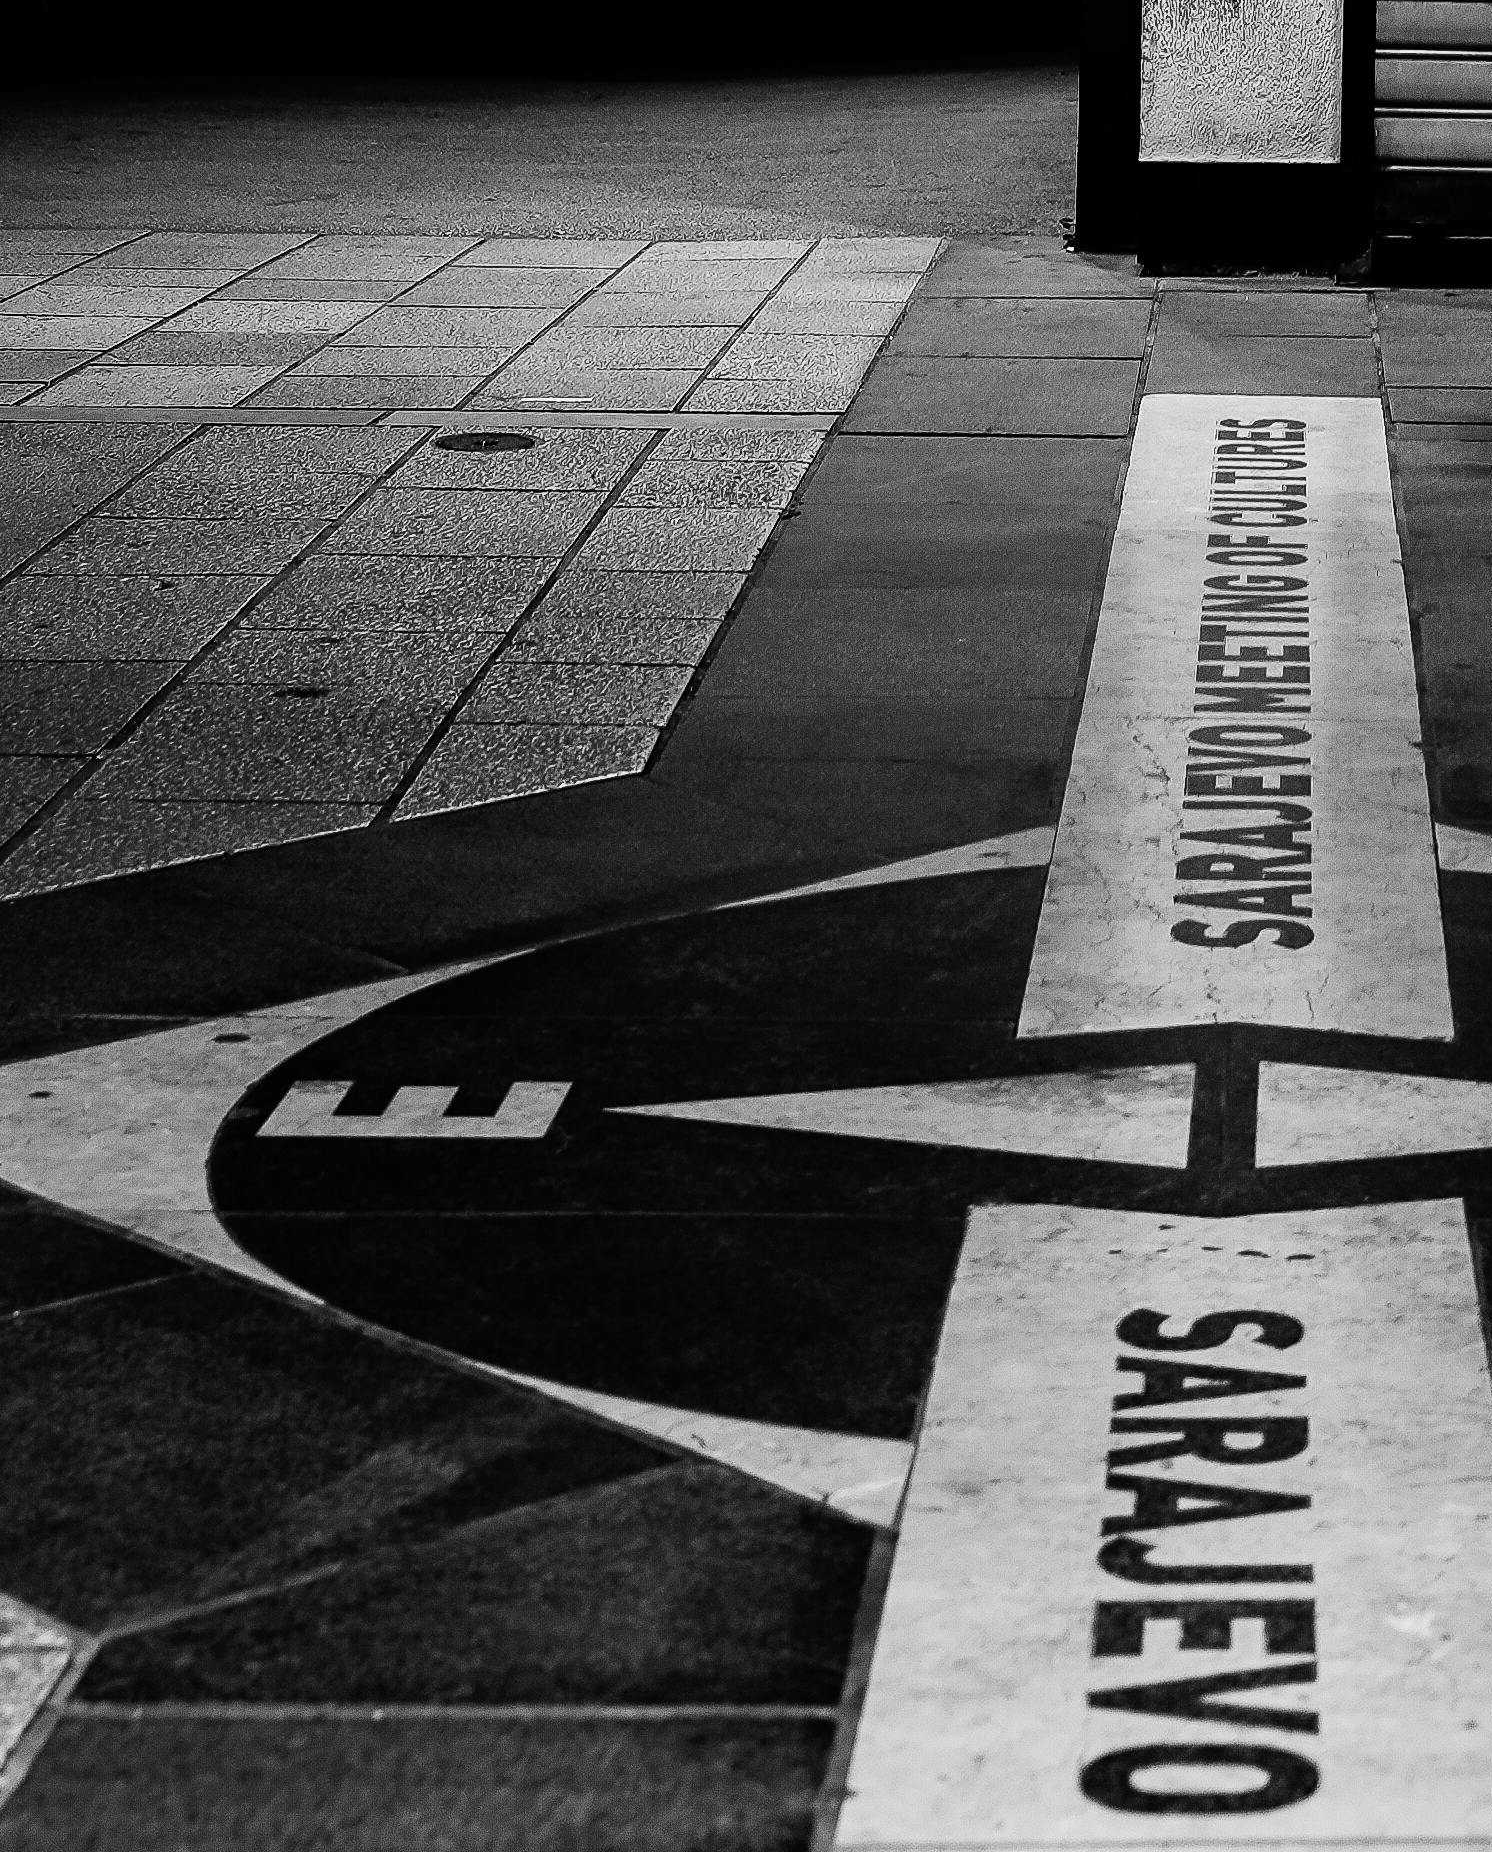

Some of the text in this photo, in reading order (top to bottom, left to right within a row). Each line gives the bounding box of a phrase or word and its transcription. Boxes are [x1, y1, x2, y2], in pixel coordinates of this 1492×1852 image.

[1170, 418, 1314, 949] SARAJEVO MEETING OF CULTURES
[255, 1080, 574, 1138] E
[1078, 1308, 1321, 1815] SARAJEVO
